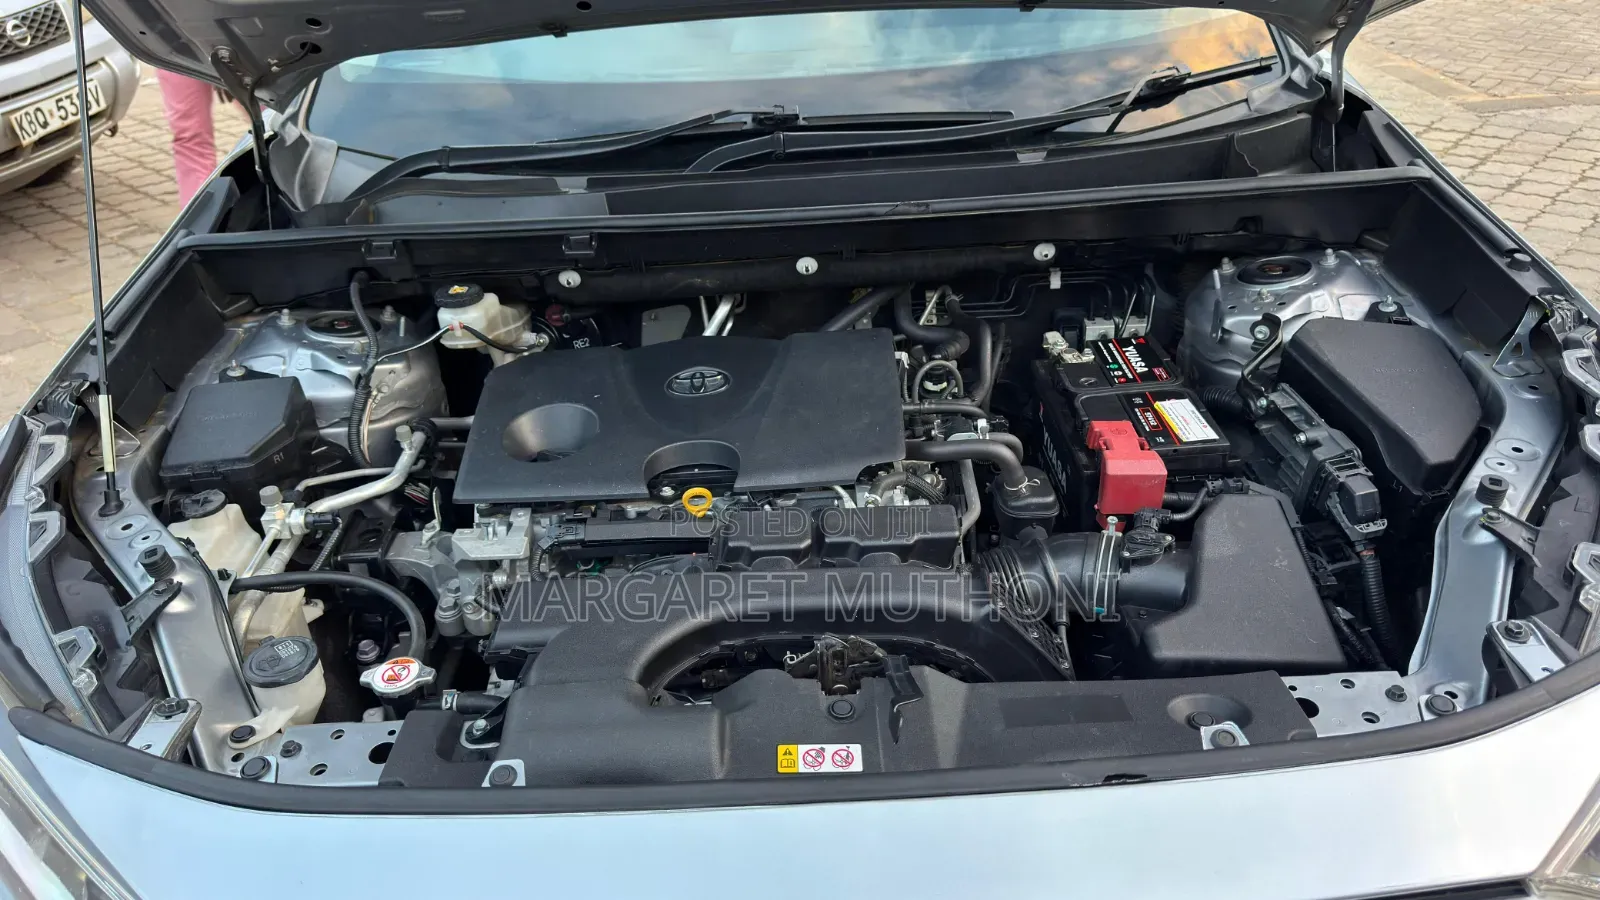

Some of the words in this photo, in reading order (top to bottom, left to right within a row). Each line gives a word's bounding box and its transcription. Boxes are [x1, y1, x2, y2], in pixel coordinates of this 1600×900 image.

[14, 106, 50, 141] KBQ
[573, 337, 590, 349] RE2
[1121, 345, 1149, 373] YUASA
[273, 452, 285, 464] R1
